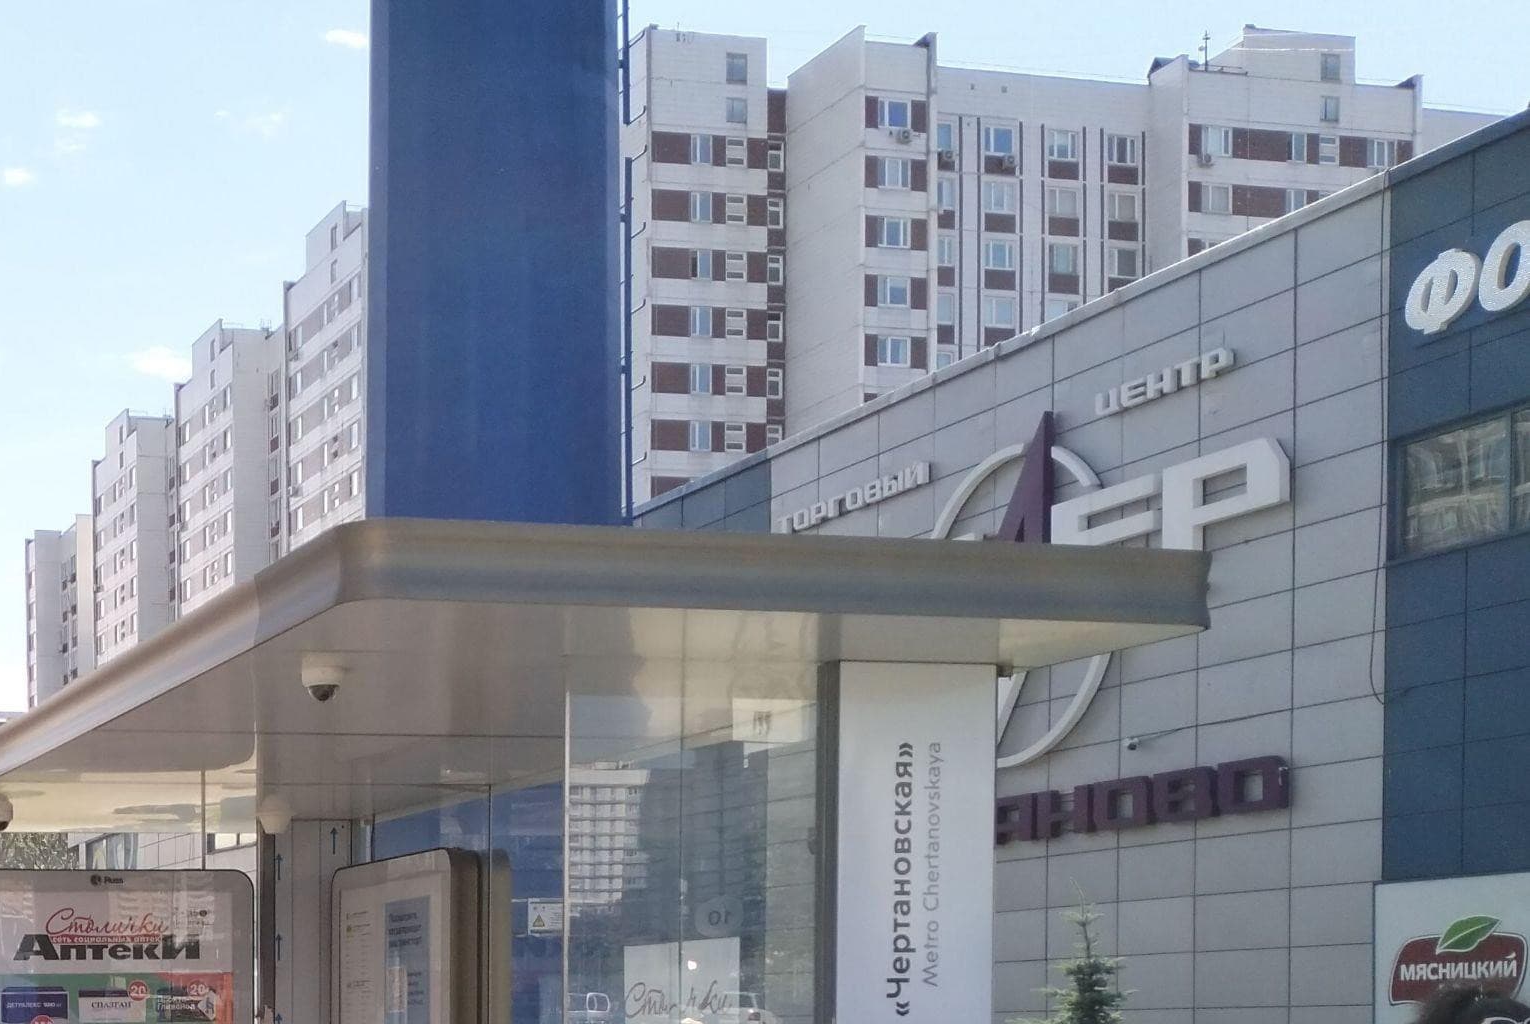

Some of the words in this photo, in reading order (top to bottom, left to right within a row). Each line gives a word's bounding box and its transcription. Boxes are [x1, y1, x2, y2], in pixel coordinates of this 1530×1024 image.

[777, 461, 932, 534] ТОРГОВЫЙ
[1094, 346, 1237, 416] ЦЕНТР
[923, 741, 945, 912] Chertanovskaya
[45, 907, 175, 935] Столички
[923, 920, 940, 988] Metro
[1399, 952, 1517, 982] МЯСНИЦКИЙ
[131, 985, 147, 996] 20
